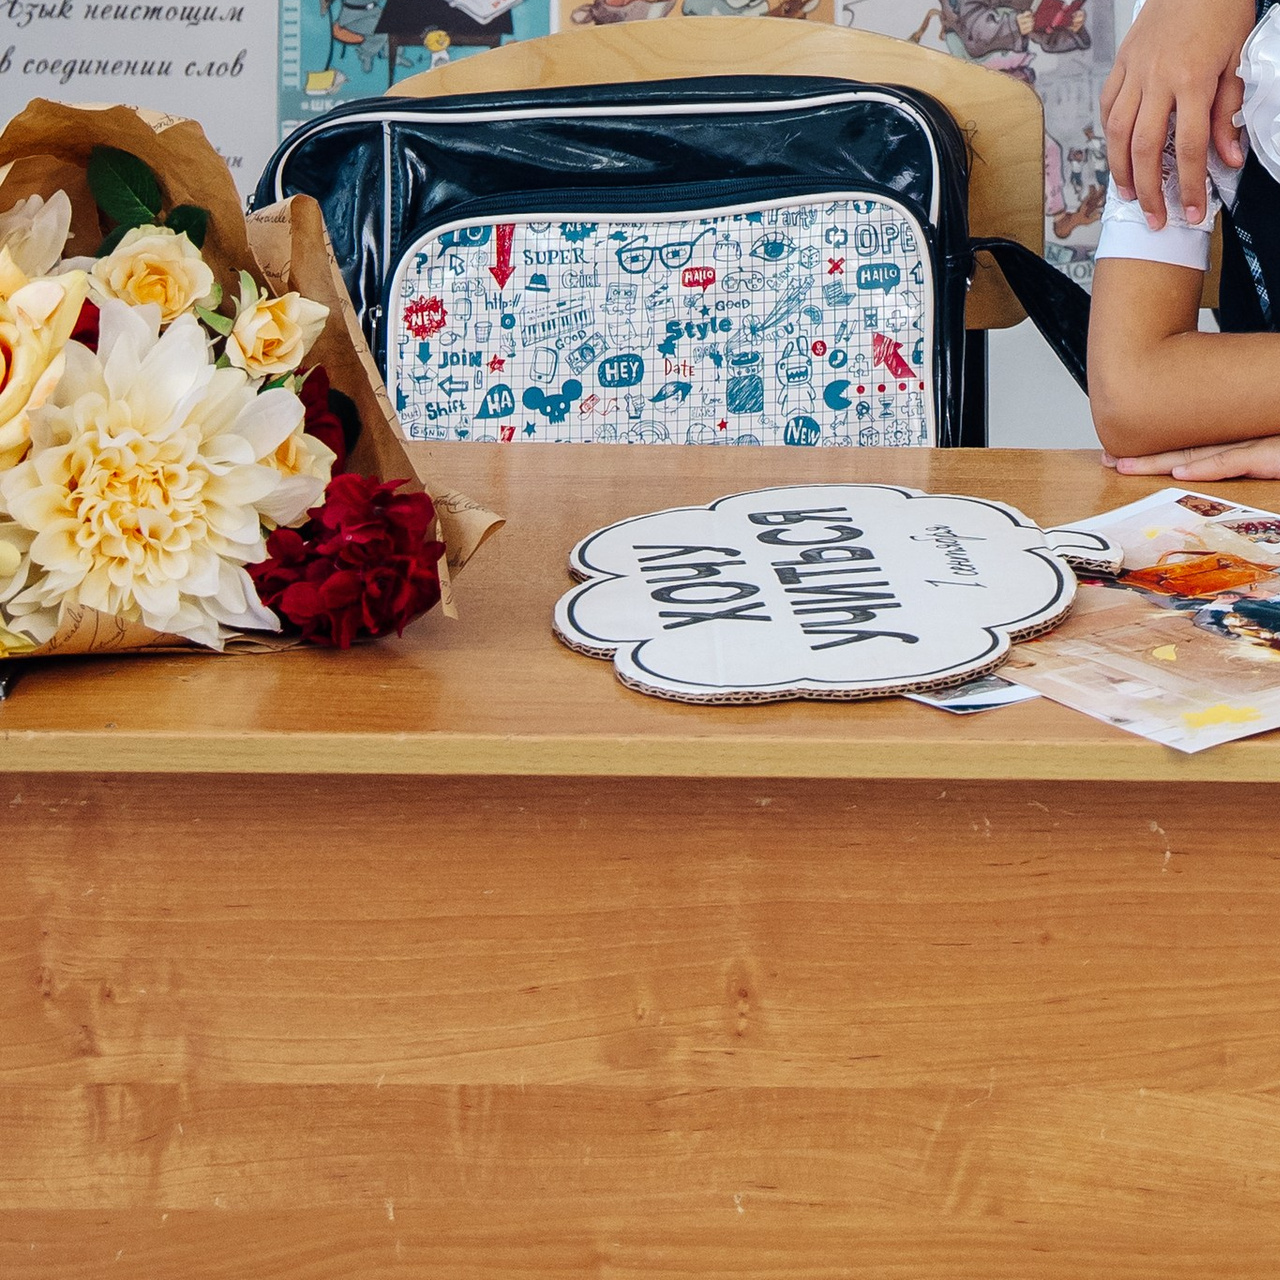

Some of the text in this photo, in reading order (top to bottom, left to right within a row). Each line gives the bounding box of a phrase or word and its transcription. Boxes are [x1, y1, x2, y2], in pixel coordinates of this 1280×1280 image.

[184, 47, 244, 78] слов
[523, 248, 589, 265] SUPER
[411, 310, 442, 328] NEW
[666, 316, 733, 340] Style
[605, 360, 640, 380] HEY
[486, 390, 513, 415] HA
[633, 544, 772, 630] ХОЧУ
[748, 506, 920, 651] УЧИТЬСЯ
